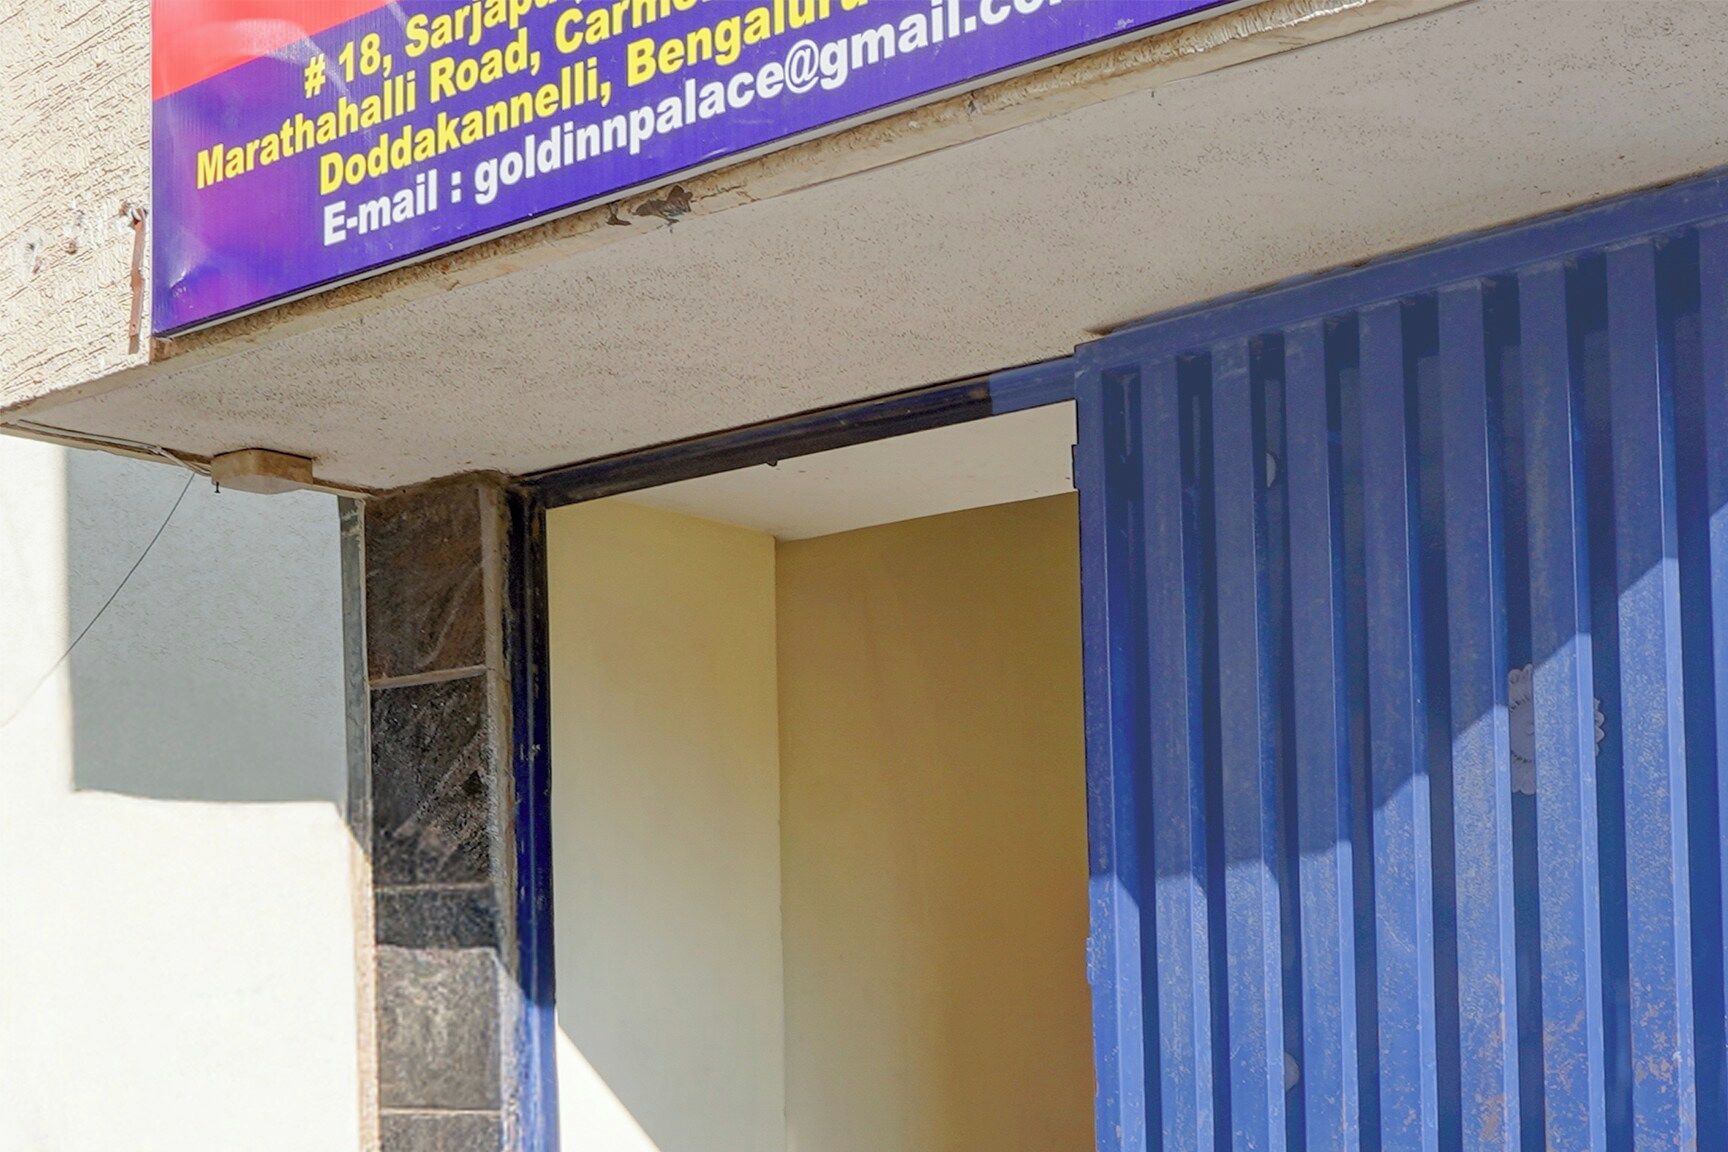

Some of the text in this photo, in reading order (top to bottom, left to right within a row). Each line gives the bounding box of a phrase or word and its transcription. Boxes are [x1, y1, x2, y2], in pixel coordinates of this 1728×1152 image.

[196, 0, 712, 189] Marathahalli Road, Carm
[303, 0, 557, 98] # 18, Sarjap
[319, 57, 611, 196] Doddakannelli,
[322, 0, 1062, 247] E-mail : goldinnpalace@gmail.c
